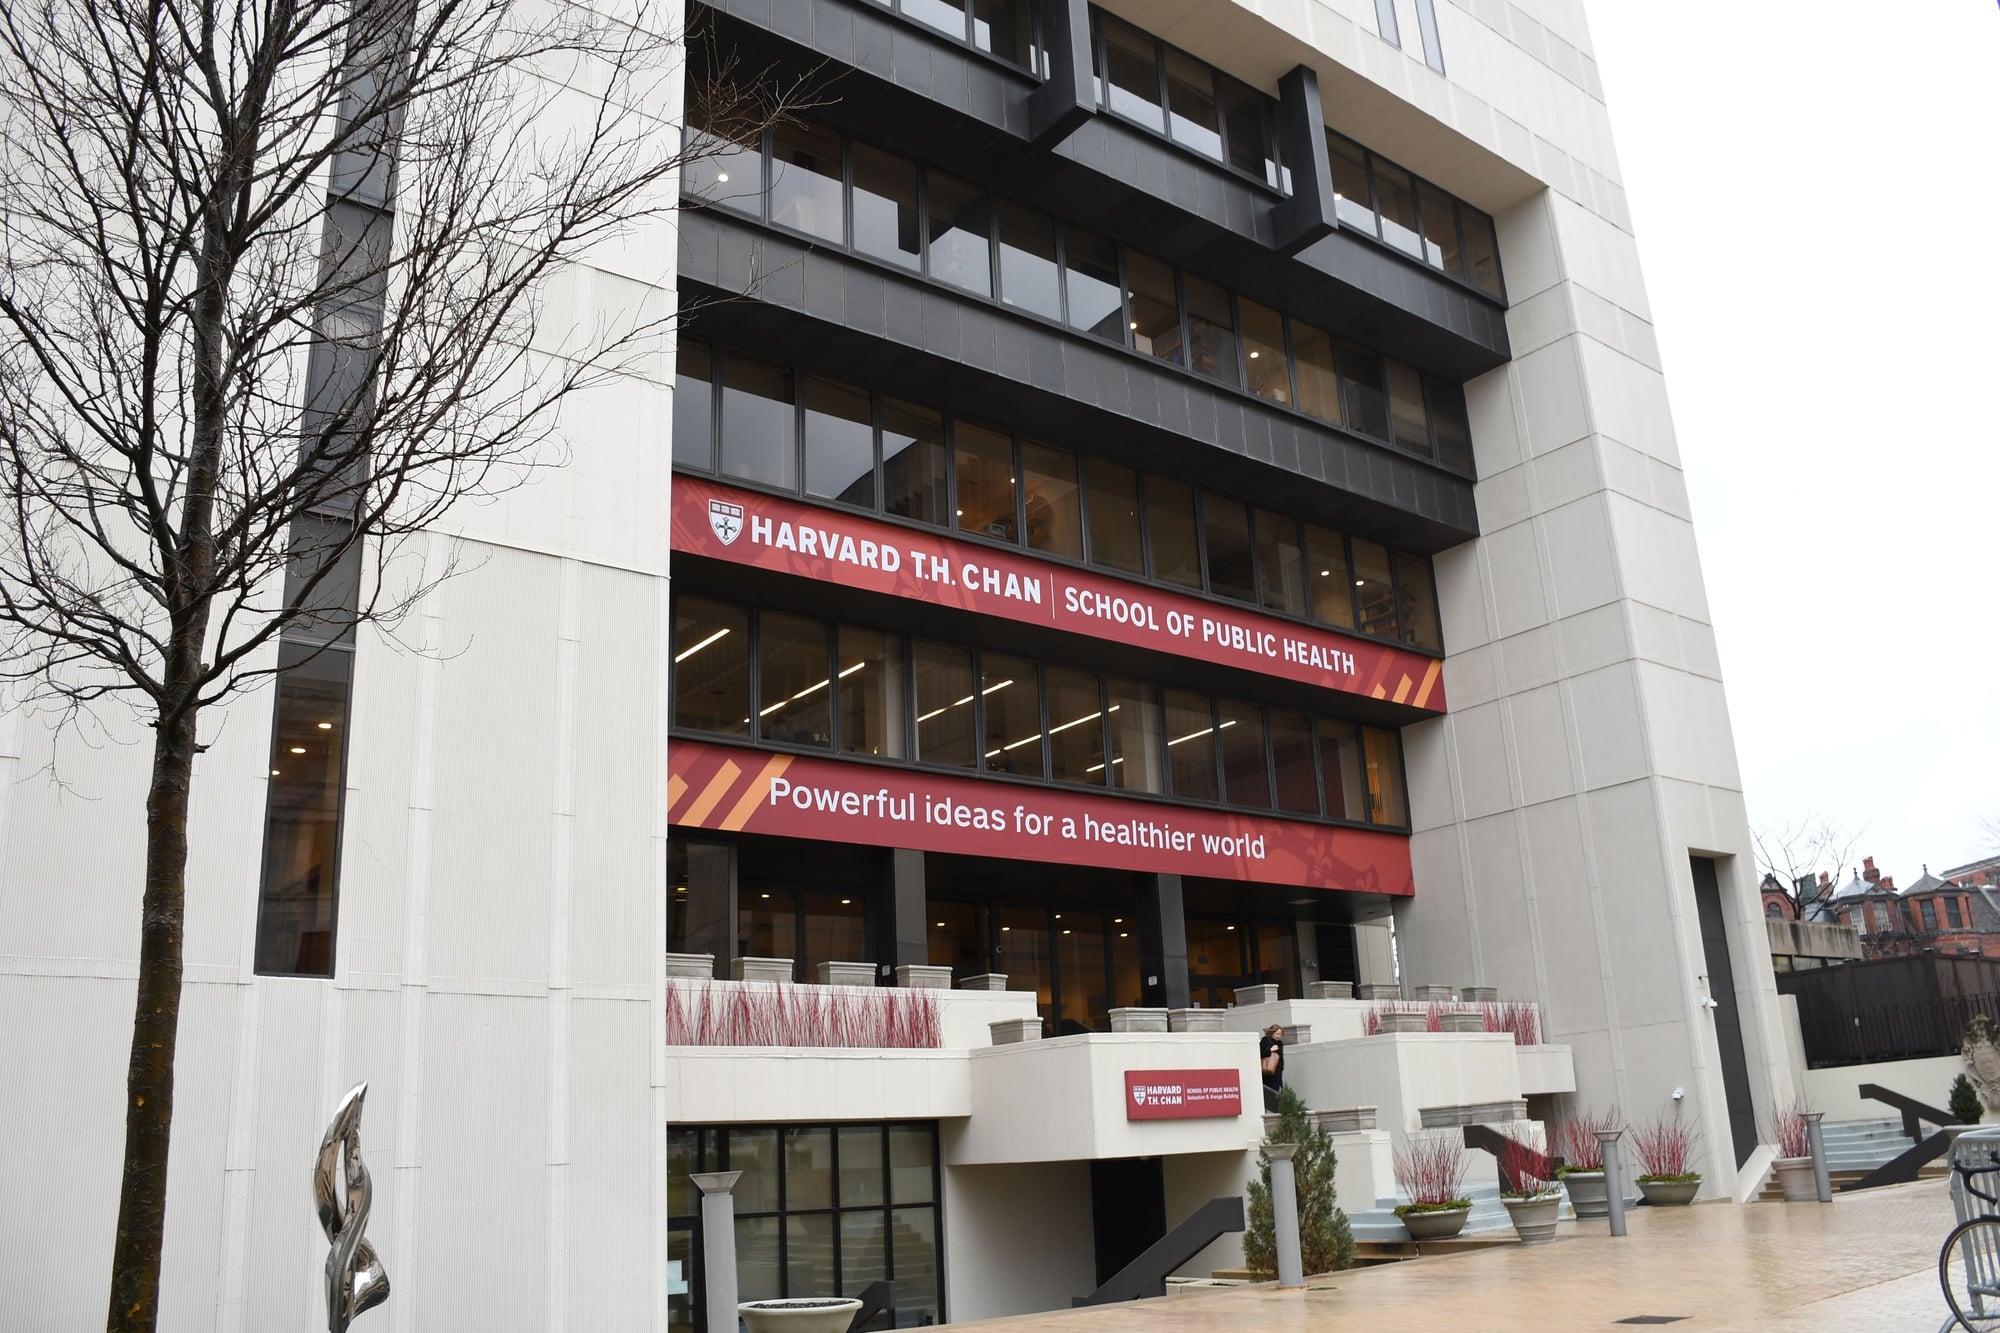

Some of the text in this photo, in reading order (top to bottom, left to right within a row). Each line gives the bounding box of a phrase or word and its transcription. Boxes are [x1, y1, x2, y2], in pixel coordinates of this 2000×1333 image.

[751, 514, 1355, 676] HARVARD T.H. CHAN SCHOOL OF PUBLIC HEALTH
[769, 775, 1266, 860] Powerful ideas for a healthier world
[1147, 1085, 1182, 1095] HARVARD
[1147, 1095, 1182, 1105] T.H. CHAN
